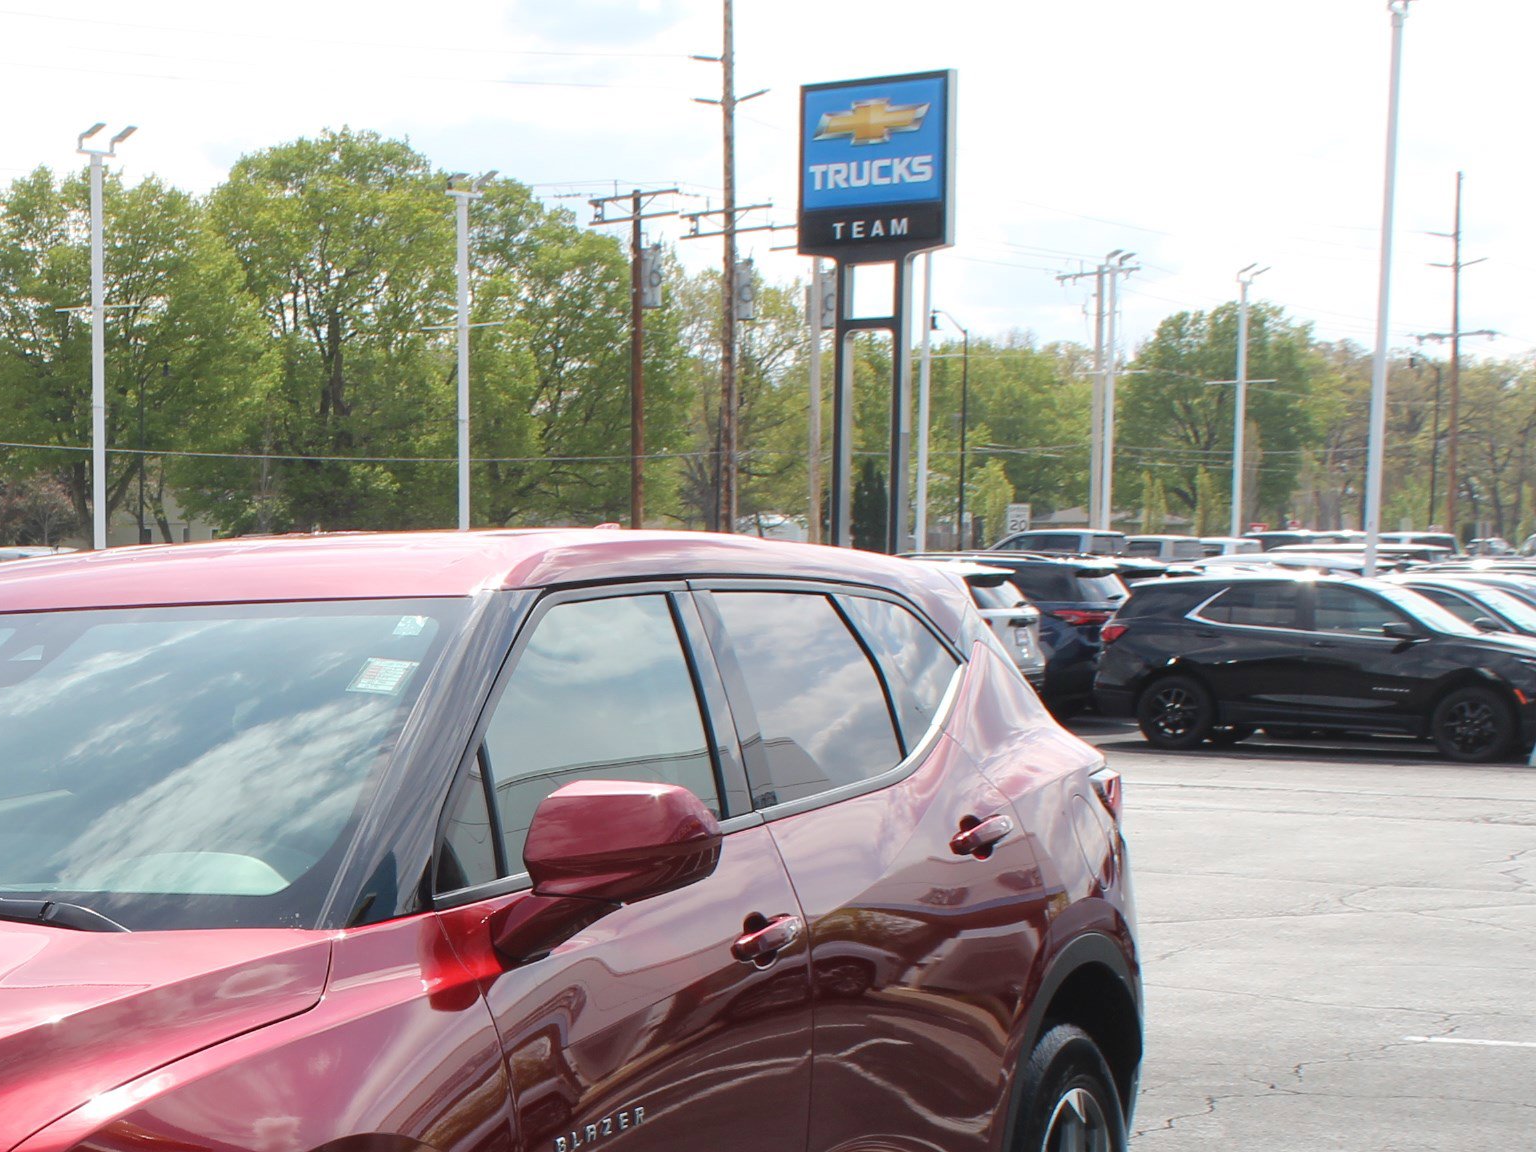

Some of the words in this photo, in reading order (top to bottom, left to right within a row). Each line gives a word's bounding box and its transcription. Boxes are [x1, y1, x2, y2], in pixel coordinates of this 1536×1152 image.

[809, 154, 933, 191] TRUCKS
[832, 217, 909, 240] TEAM
[1009, 519, 1027, 532] 20
